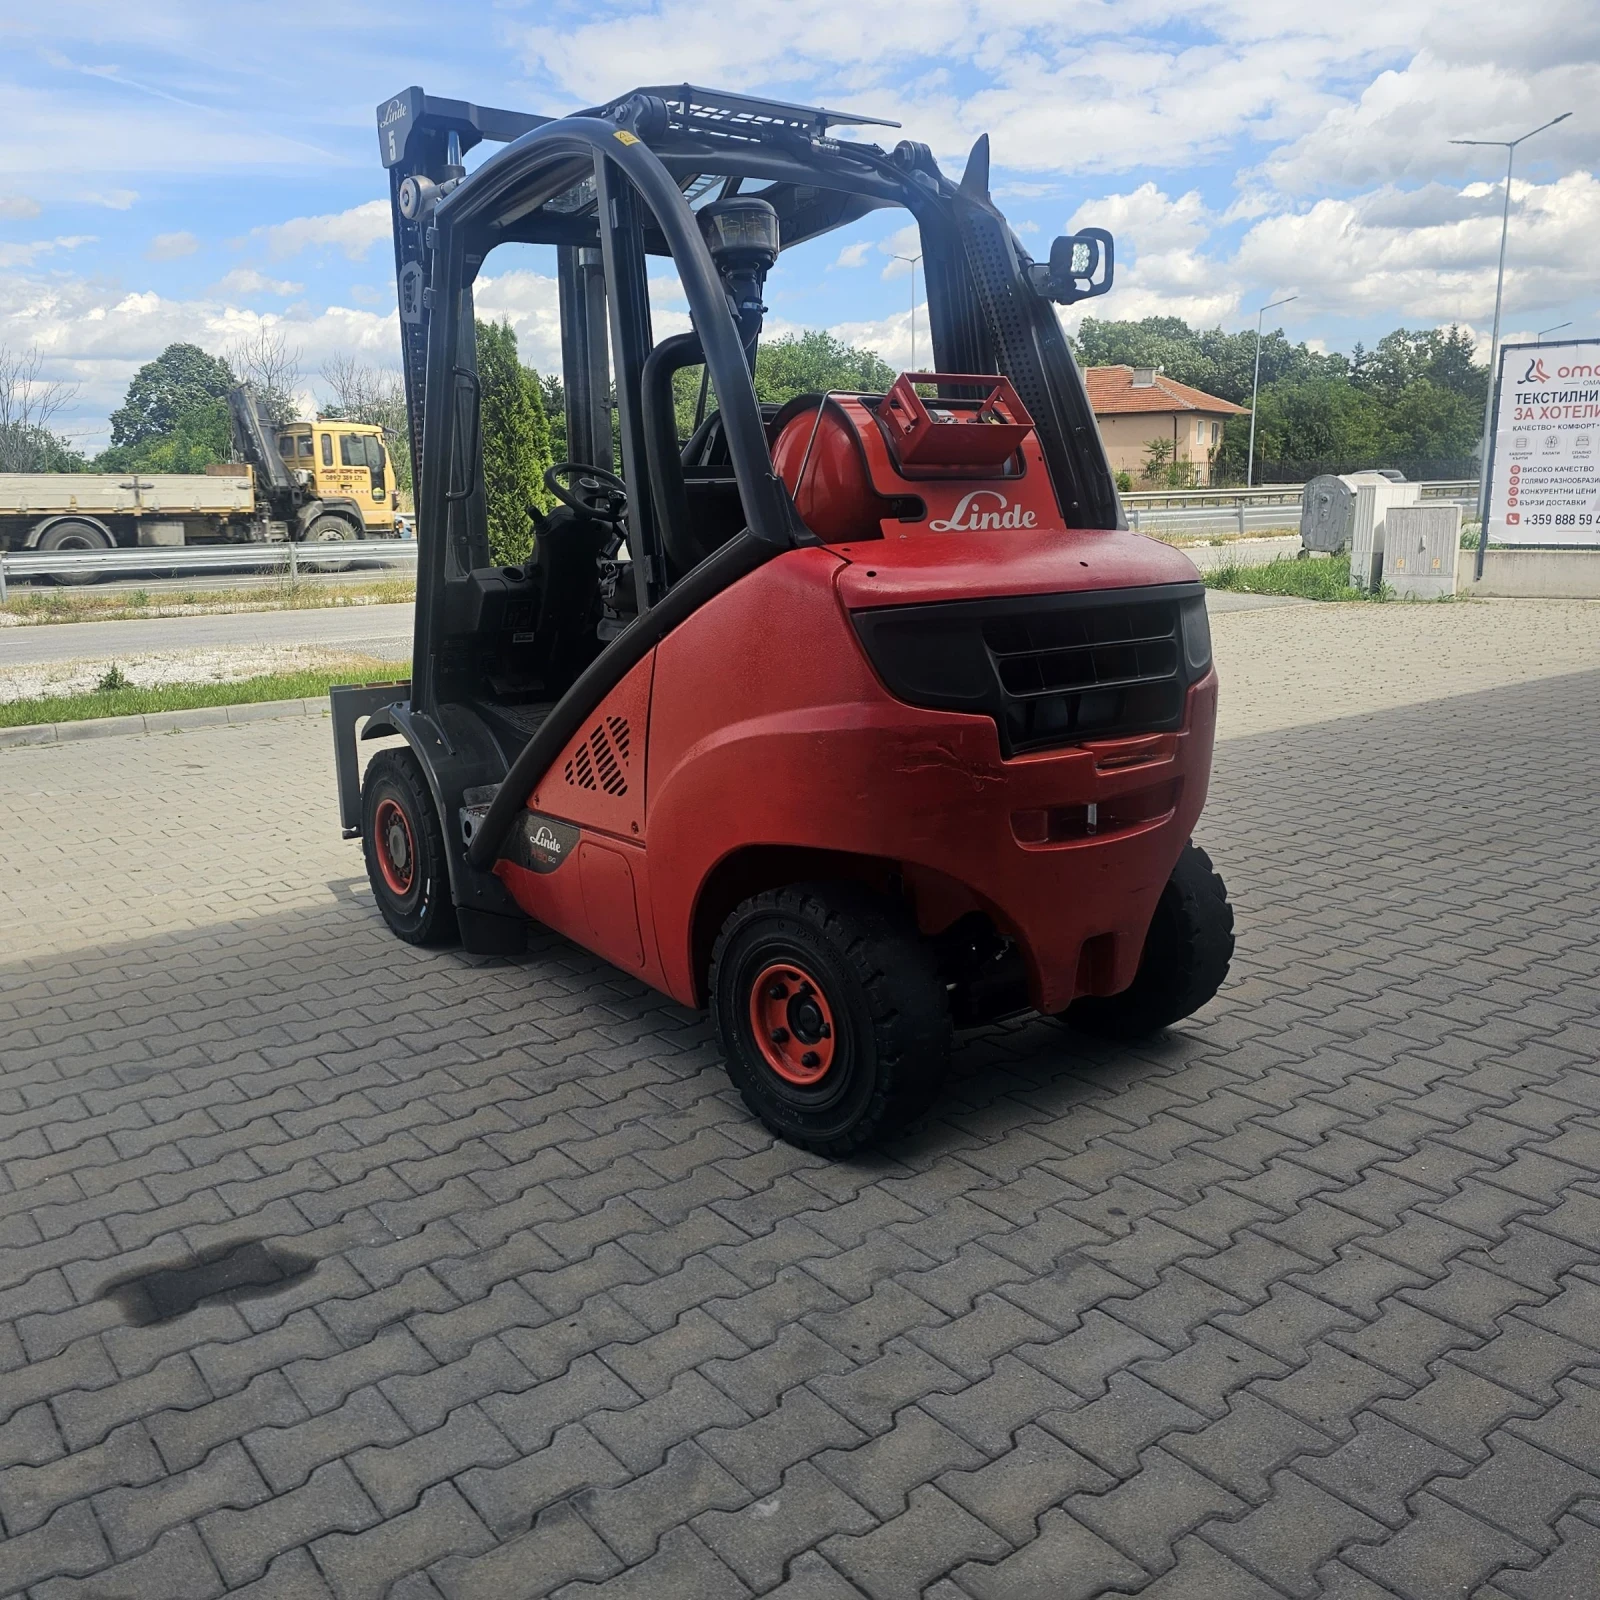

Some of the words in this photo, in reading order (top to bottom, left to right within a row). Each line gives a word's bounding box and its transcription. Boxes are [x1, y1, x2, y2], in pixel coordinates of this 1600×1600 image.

[380, 100, 407, 128] Linde
[388, 130, 396, 161] 5
[1515, 390, 1599, 404] ТЕКСТИЛНИ
[1514, 407, 1534, 420] ЗА
[929, 490, 1038, 532] Linde
[1524, 514, 1552, 525] +359
[1555, 514, 1576, 525] 888
[1578, 514, 1592, 525] 59
[529, 826, 561, 853] Linde
